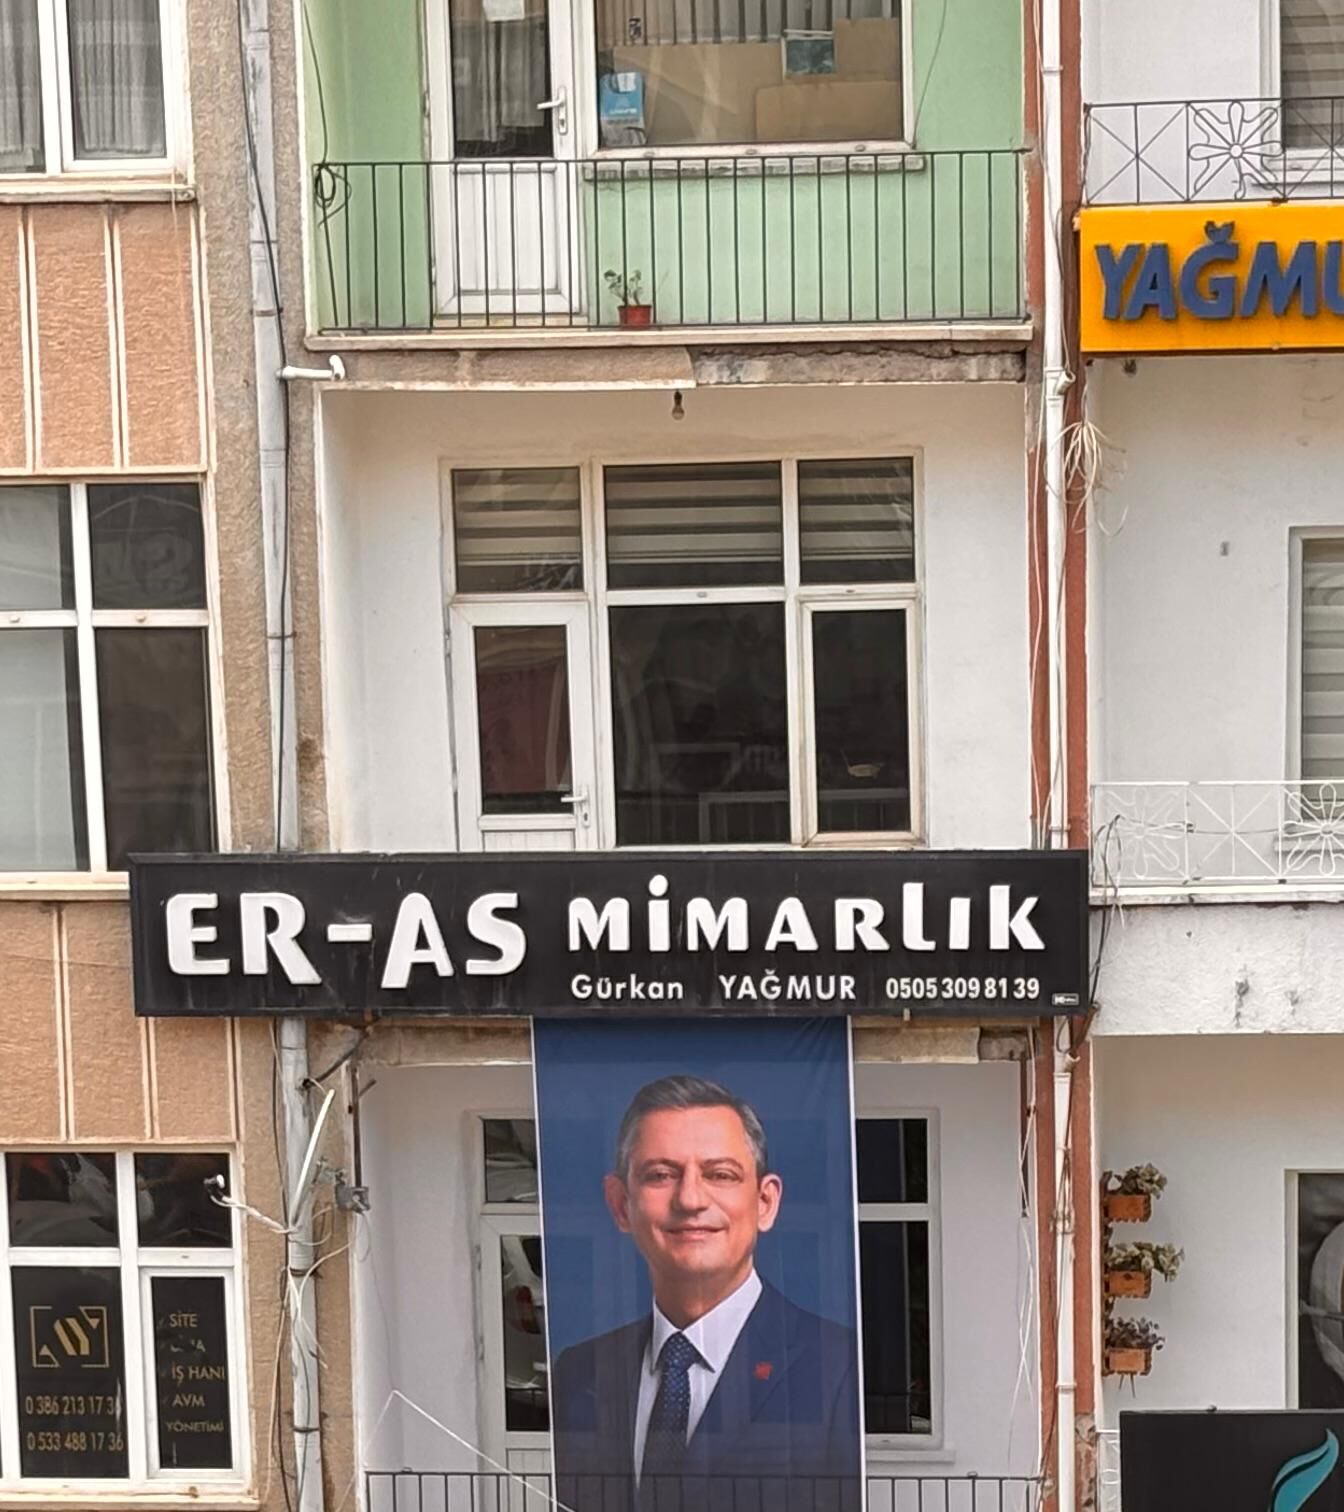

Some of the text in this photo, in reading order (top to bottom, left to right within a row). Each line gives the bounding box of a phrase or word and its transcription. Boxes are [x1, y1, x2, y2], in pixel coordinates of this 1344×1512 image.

[166, 874, 1046, 988] ER-AS MİMARLIK
[570, 973, 684, 1000] Gürkan
[720, 969, 856, 1000] YAĞMUR
[169, 1311, 198, 1327] SİTE
[172, 1364, 225, 1386] İŞ HANI
[64, 1396, 85, 1414] 213
[172, 1394, 205, 1407] AVM
[27, 1432, 123, 1450] 0 533 488 17 36
